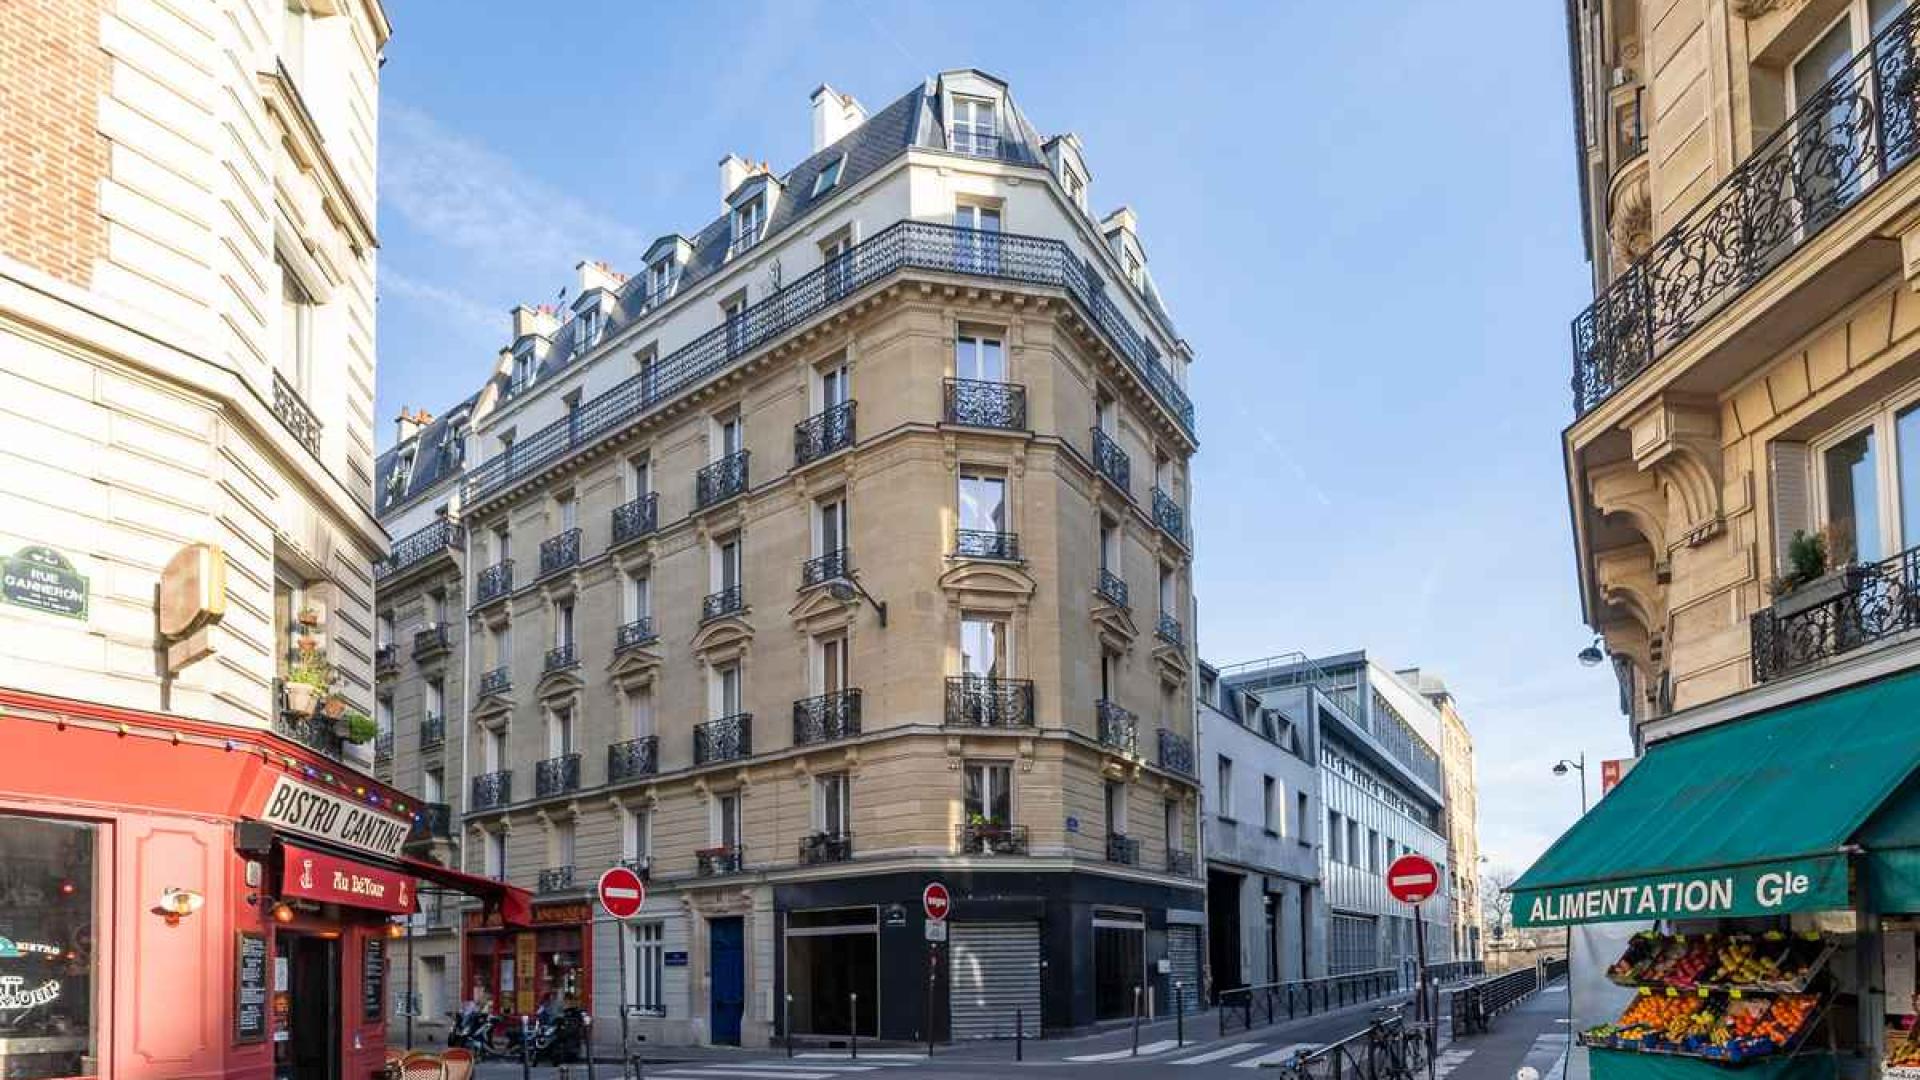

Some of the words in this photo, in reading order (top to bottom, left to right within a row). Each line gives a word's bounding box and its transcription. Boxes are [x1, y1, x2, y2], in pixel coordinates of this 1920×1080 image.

[30, 568, 59, 585] RUE
[269, 784, 340, 834] BISTRO
[341, 810, 407, 853] CANTINE
[333, 871, 348, 891] Au
[1530, 878, 1732, 922] ALIMENTATION
[1756, 871, 1809, 907] Gle
